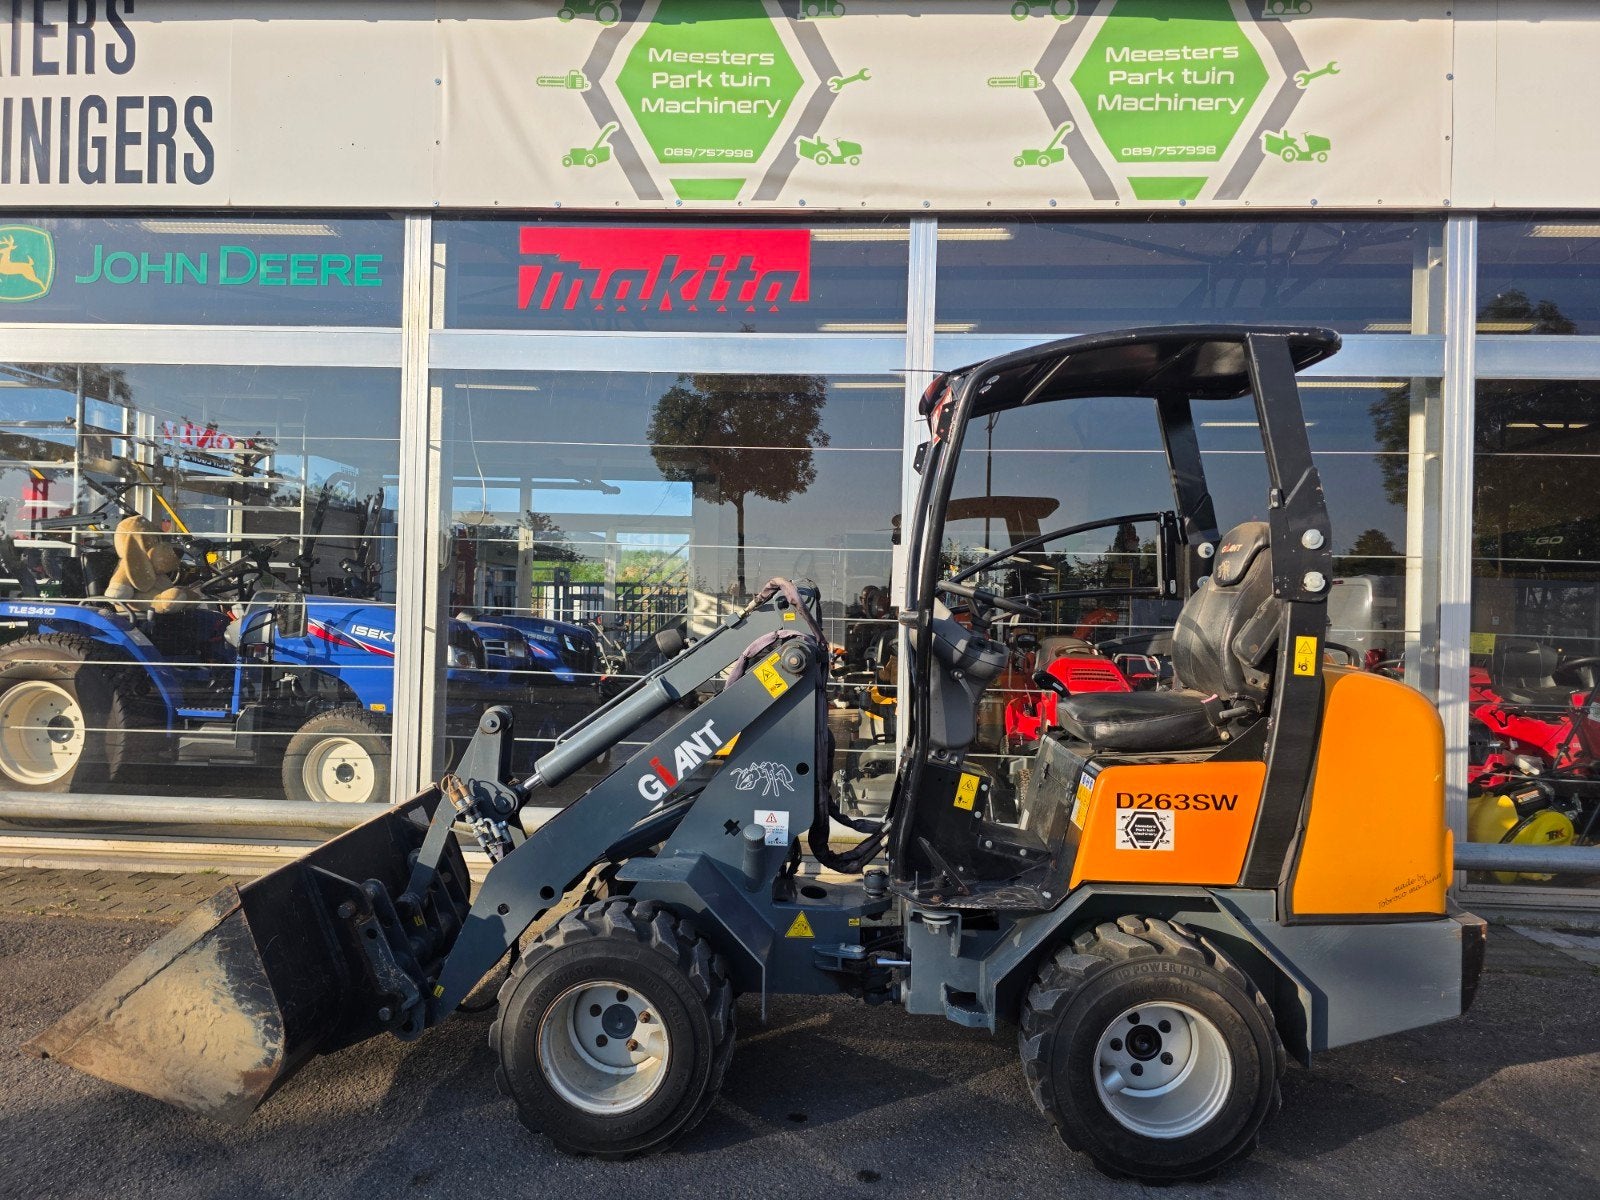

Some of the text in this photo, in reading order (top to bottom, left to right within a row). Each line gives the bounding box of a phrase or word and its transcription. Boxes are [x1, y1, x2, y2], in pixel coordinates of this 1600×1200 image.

[648, 48, 774, 66] Meesters
[1106, 46, 1238, 63] Meesters
[652, 71, 770, 89] Park tuin
[1109, 68, 1234, 85] Park tuin
[641, 97, 781, 118] Machinery
[1097, 93, 1244, 115] Machinery
[663, 147, 754, 158] 089/757998
[1121, 146, 1217, 156] 089/757998
[9, 605, 56, 615] TLE3410
[1116, 792, 1238, 811] D263SW
[1133, 961, 1176, 975] POWER
